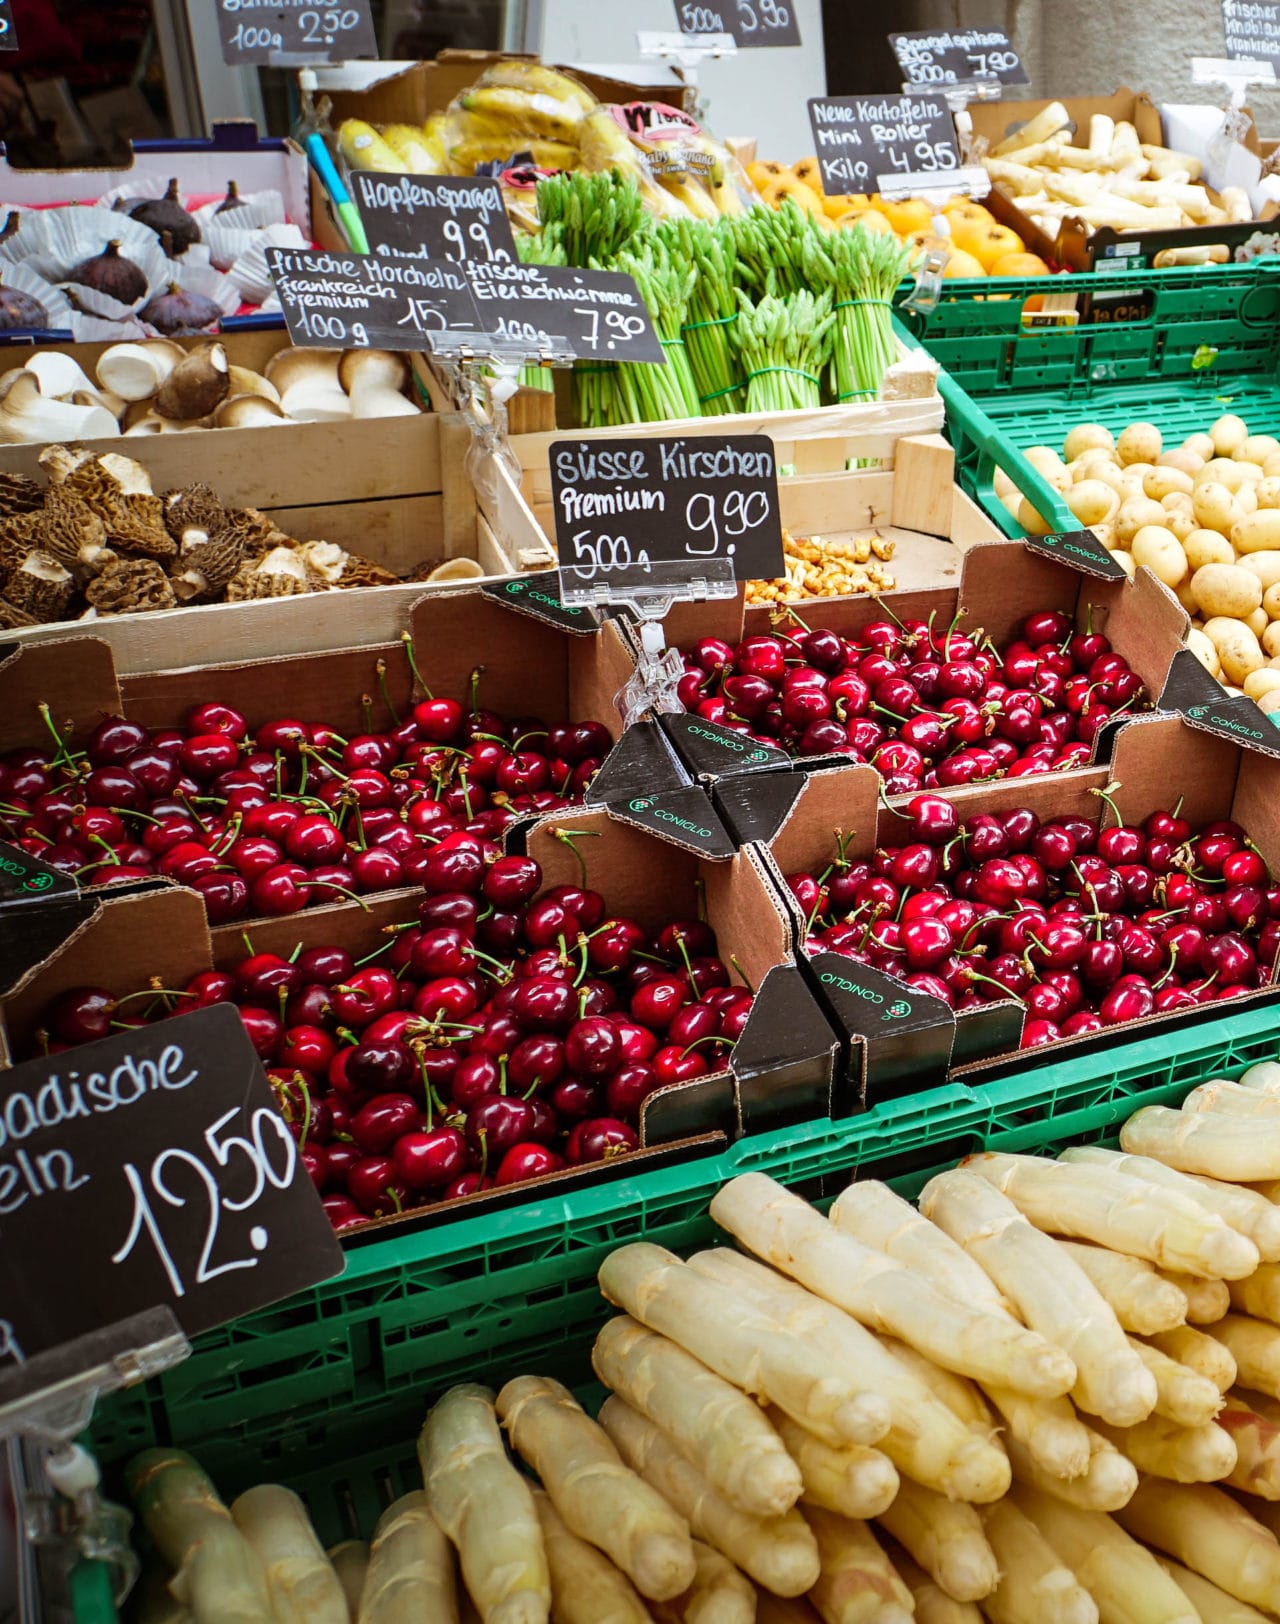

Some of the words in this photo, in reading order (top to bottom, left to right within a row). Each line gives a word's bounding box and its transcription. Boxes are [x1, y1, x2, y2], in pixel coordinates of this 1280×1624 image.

[229, 24, 283, 51] 100g
[299, 10, 360, 44] 2.50
[813, 103, 855, 124] Neue
[857, 97, 943, 125] Kartoffeln
[817, 129, 862, 146] Mini
[822, 158, 868, 180] Kilo
[359, 176, 503, 225] Hopfenspargel
[363, 259, 466, 290] Morcheln
[659, 441, 773, 482] Kirschen
[560, 486, 665, 524] Premium
[1063, 543, 1110, 565] CONIGLIO
[687, 725, 744, 752] CONIGLIO
[1210, 716, 1264, 739] CONIGLIO
[654, 809, 712, 837] CONIGLIO
[820, 973, 884, 1004] CONIGLIO
[112, 1107, 297, 1297] 12.50
